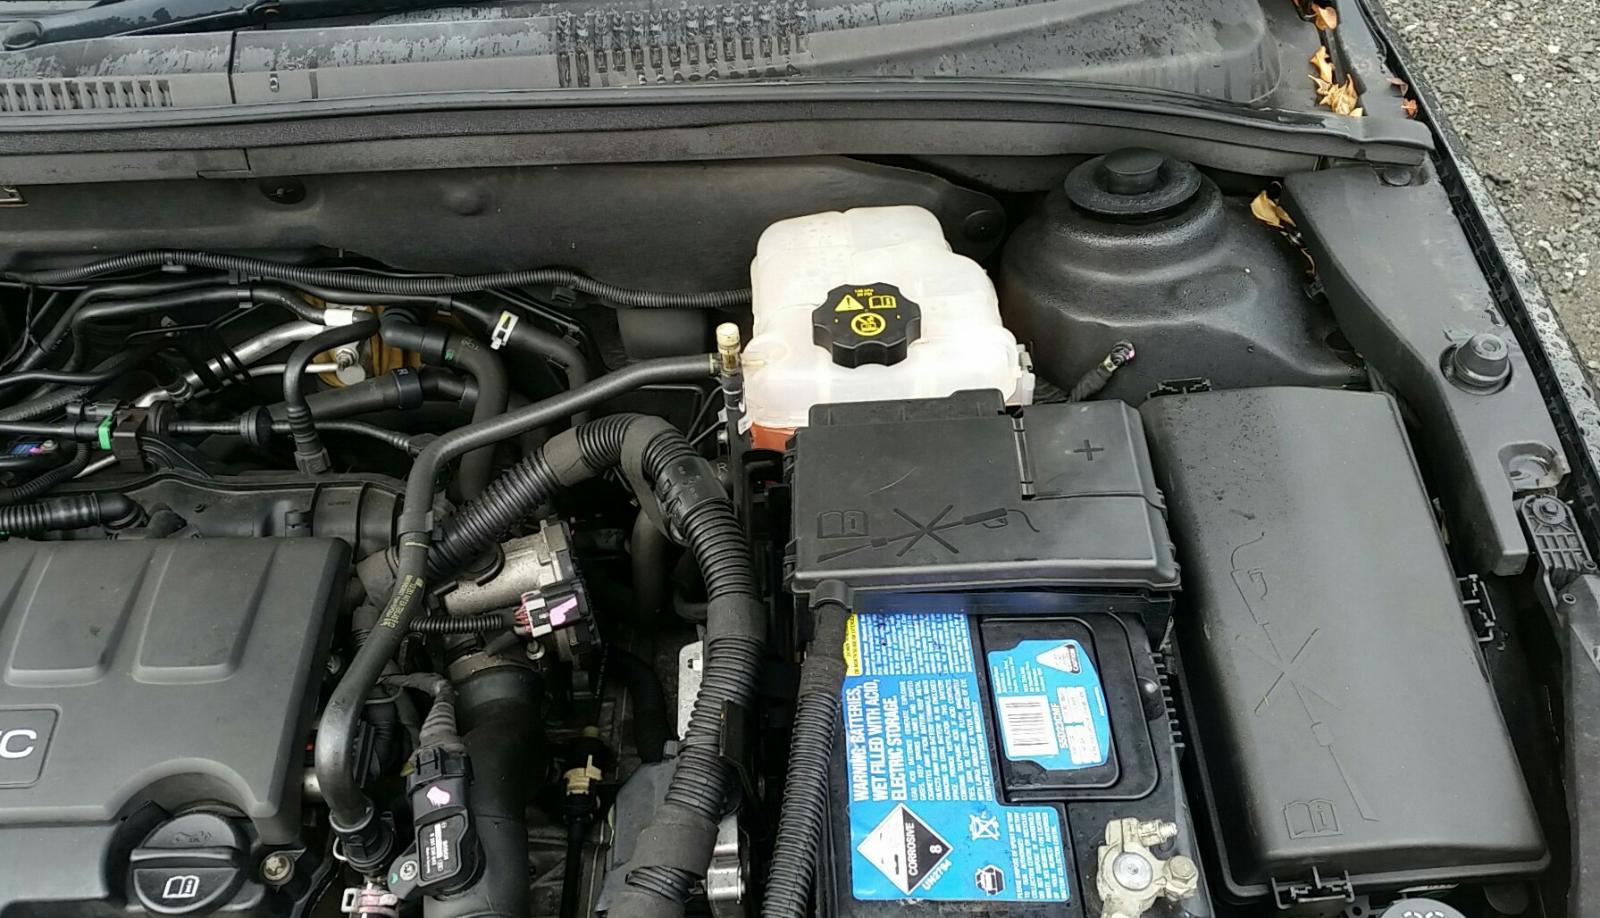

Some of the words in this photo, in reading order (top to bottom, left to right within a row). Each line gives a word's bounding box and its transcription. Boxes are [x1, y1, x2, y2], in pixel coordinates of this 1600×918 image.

[863, 679, 880, 706] ACID,
[846, 684, 865, 744] BATTERIES,
[865, 707, 883, 736] WITH
[0, 729, 37, 758] C
[869, 737, 886, 774] FILLED
[851, 745, 869, 801] WARNING:
[871, 775, 888, 801] WET
[888, 747, 908, 801] ELECTRIC
[905, 822, 918, 876] CORROSIVE
[930, 844, 942, 854] 8
